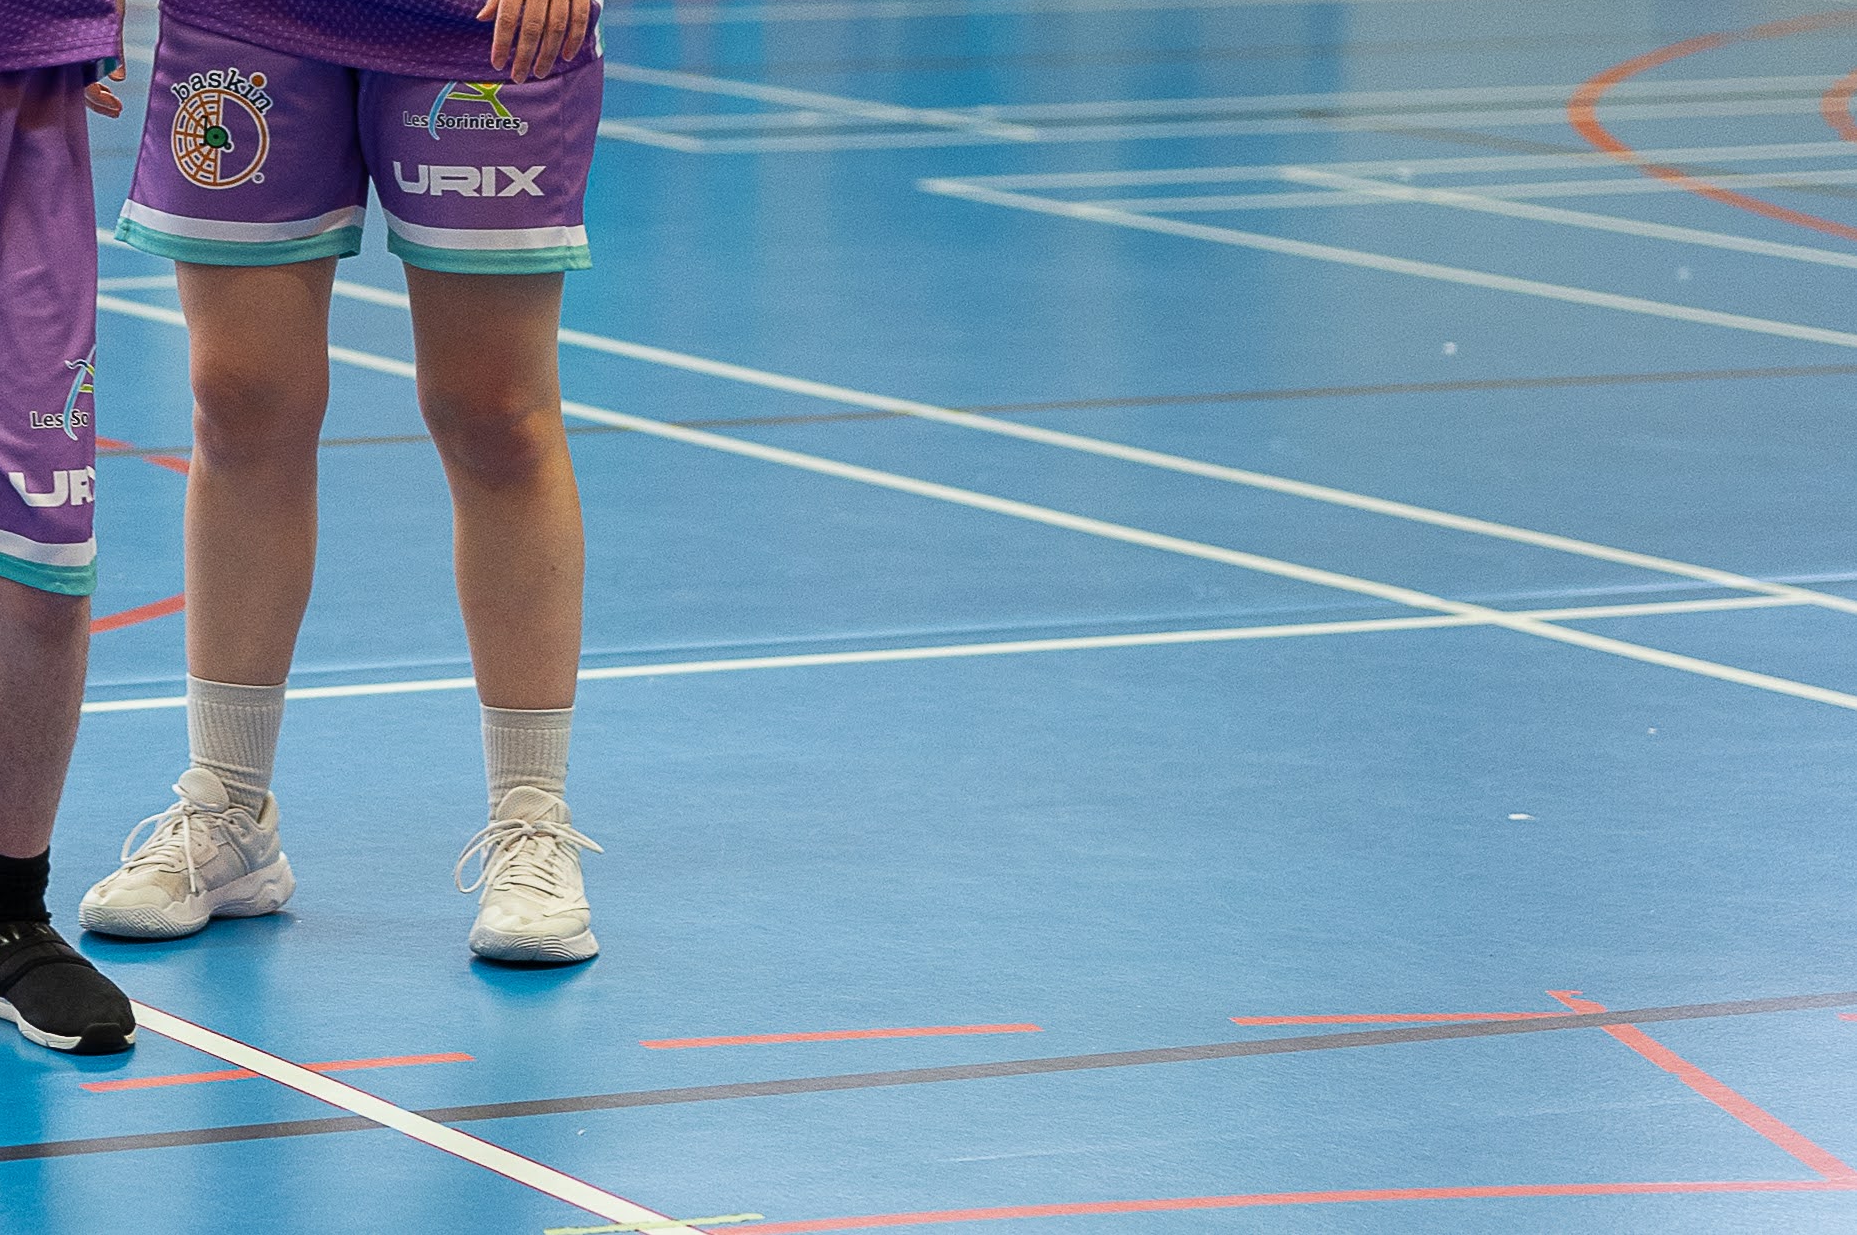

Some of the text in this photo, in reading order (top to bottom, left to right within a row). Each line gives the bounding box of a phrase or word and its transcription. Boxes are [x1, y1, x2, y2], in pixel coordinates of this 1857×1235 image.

[171, 67, 273, 115] baskin
[403, 111, 522, 130] Les Sorinières
[393, 160, 547, 198] URIX
[30, 410, 64, 429] Les
